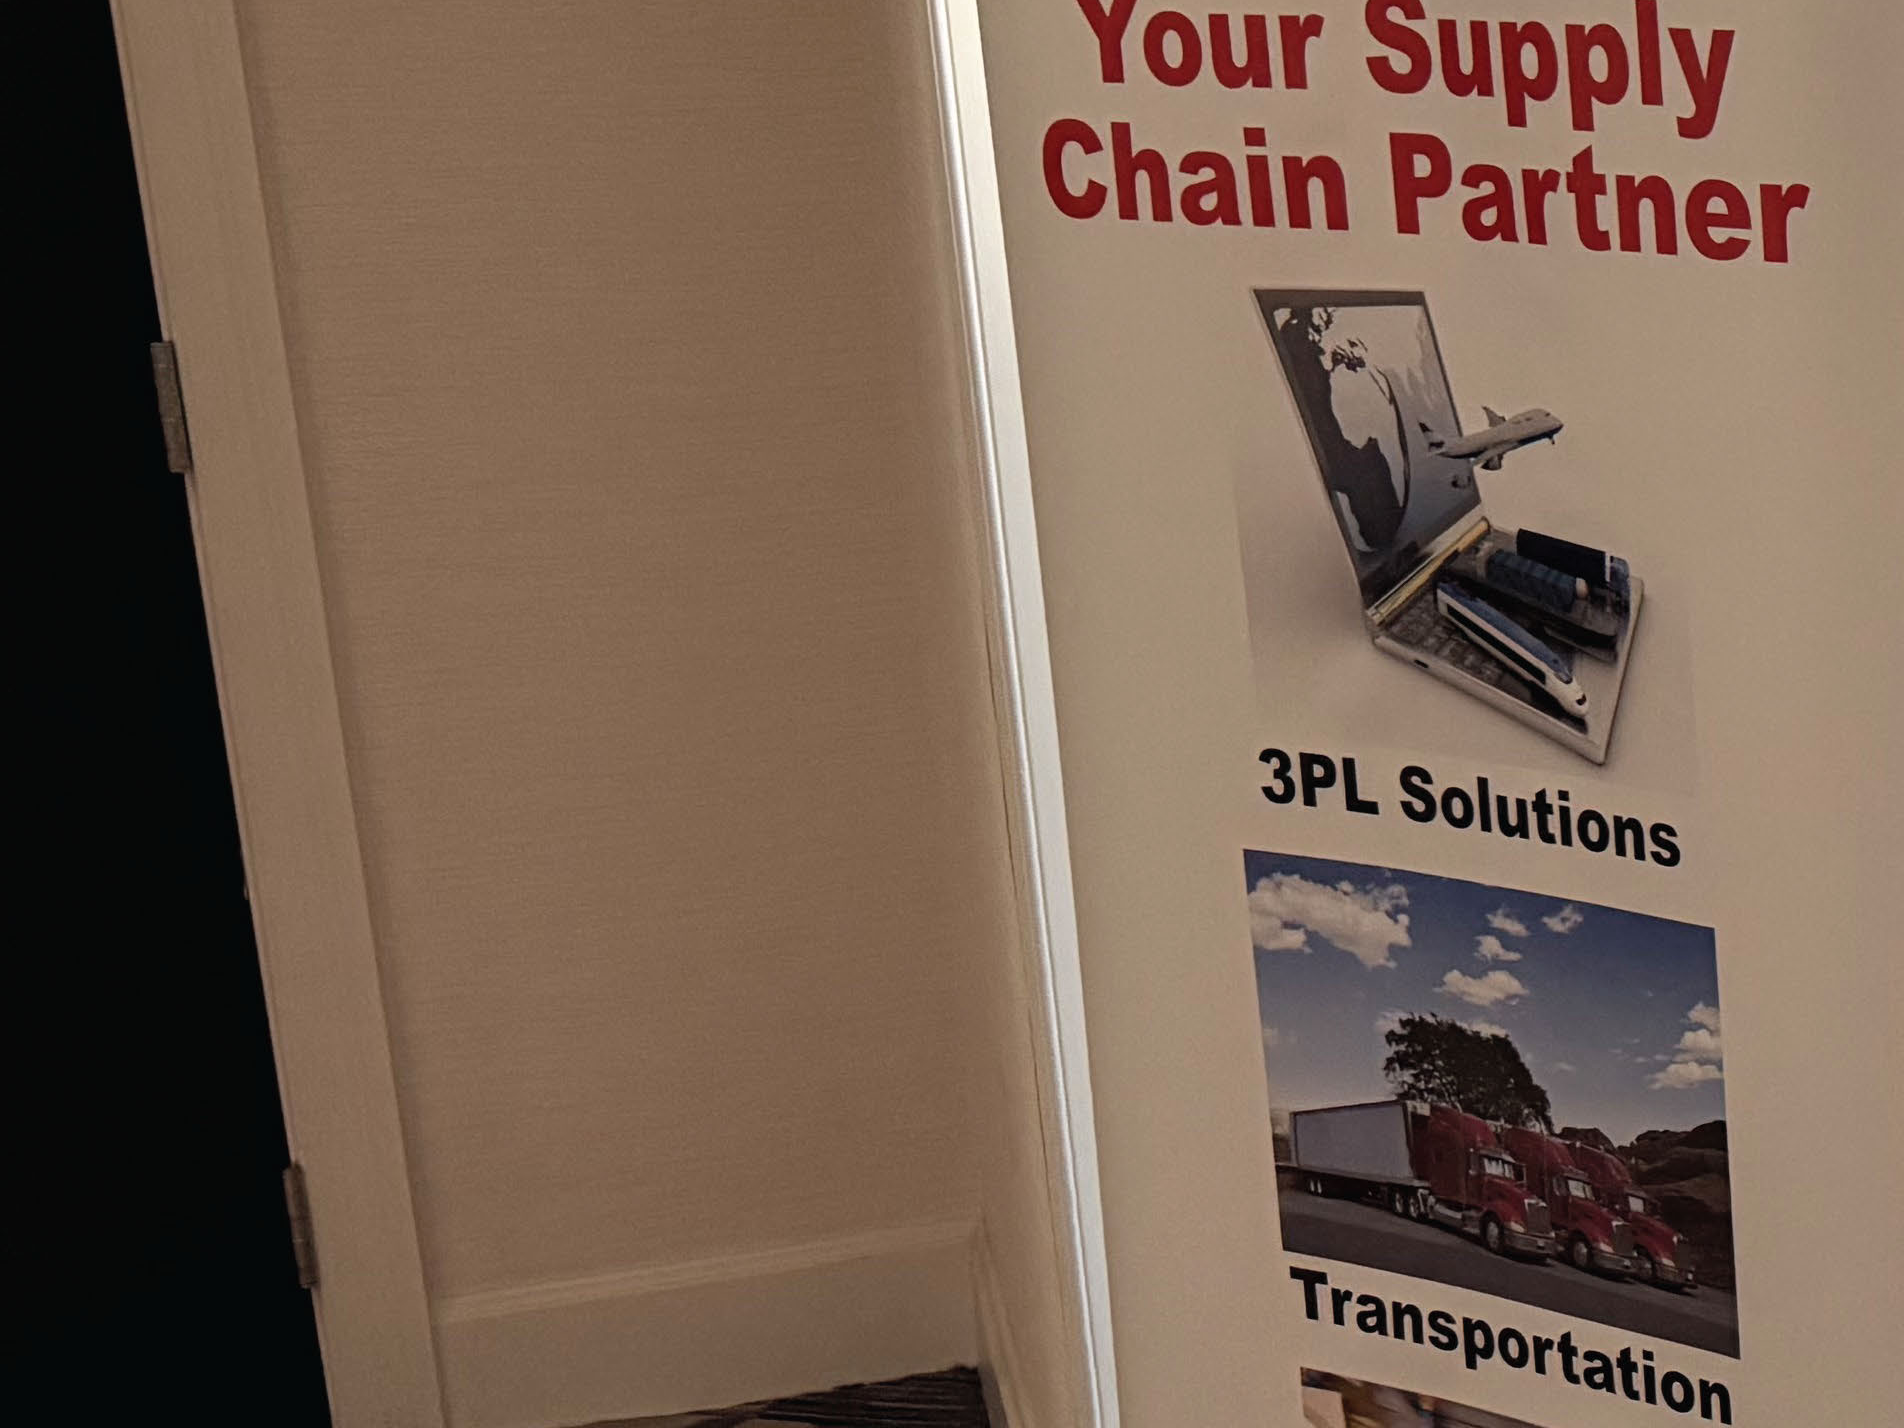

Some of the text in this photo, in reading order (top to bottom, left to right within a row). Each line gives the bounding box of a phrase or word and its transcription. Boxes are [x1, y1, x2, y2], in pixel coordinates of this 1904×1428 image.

[1042, 118, 1810, 264] Chain Partner
[1257, 747, 1682, 868] 3PL Solutions
[1289, 1266, 1734, 1426] Transportation
